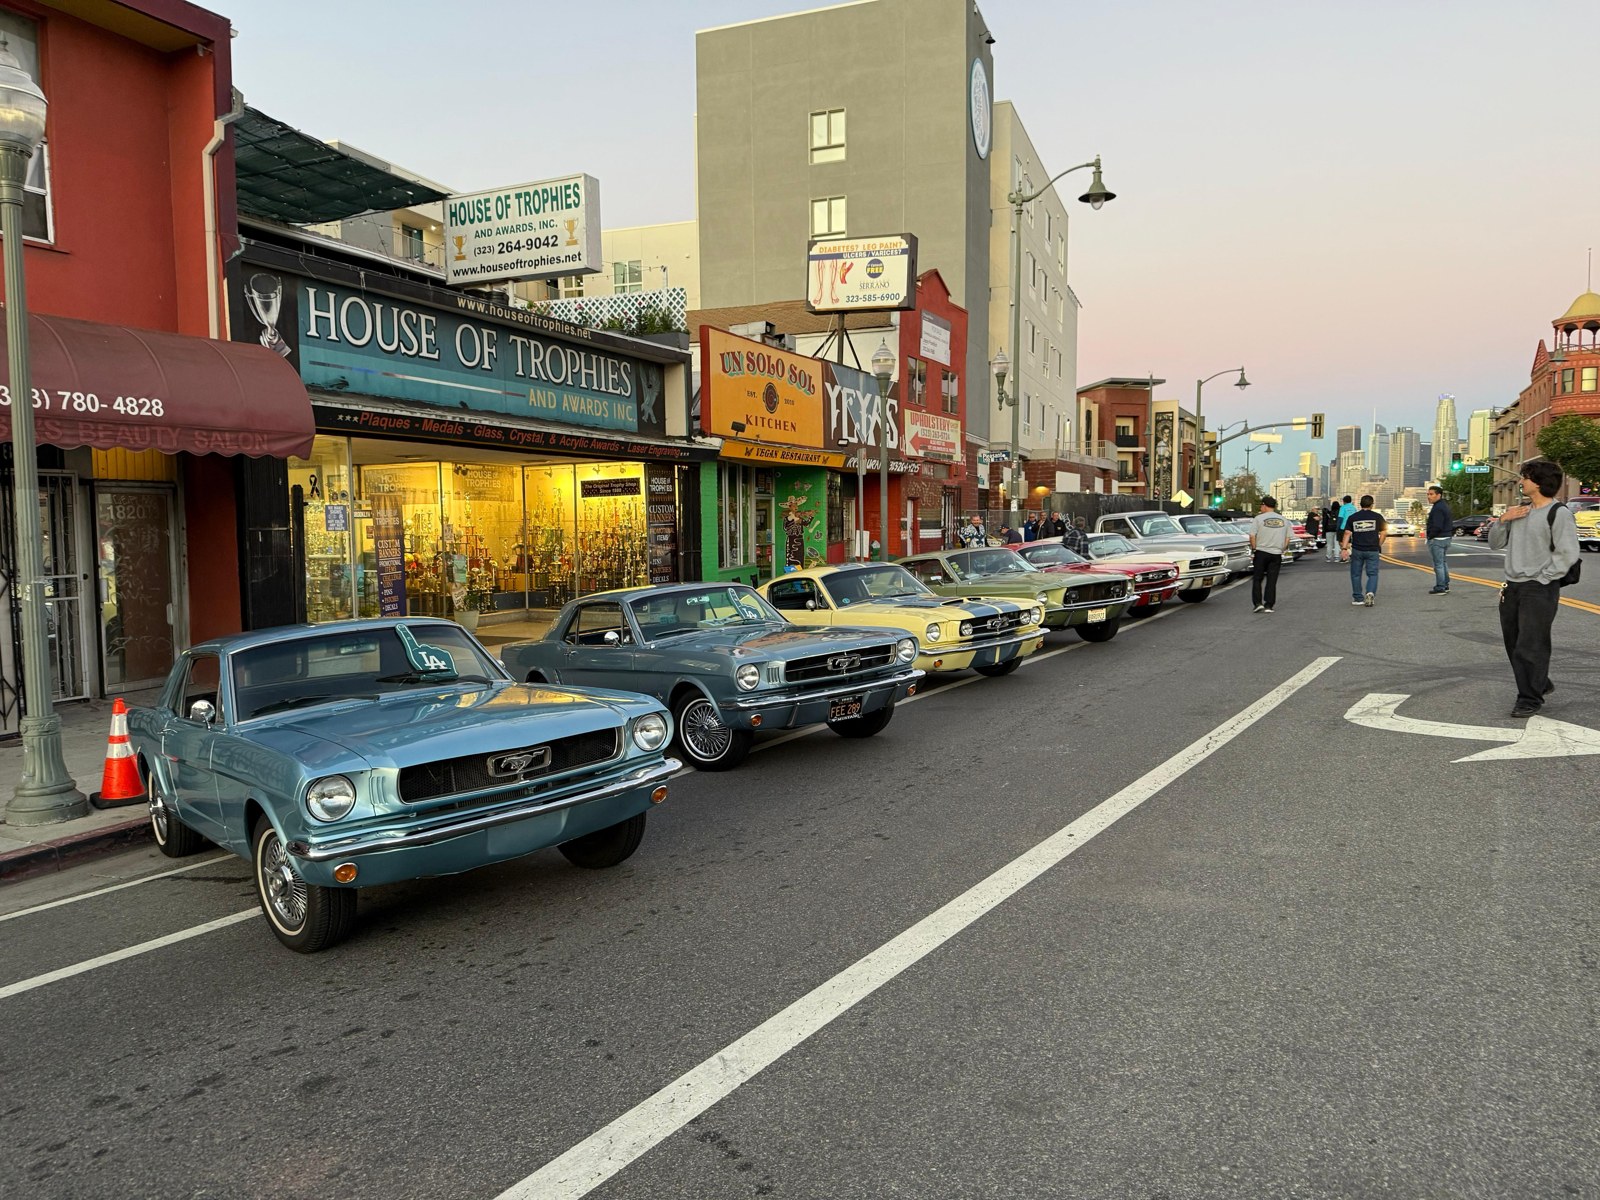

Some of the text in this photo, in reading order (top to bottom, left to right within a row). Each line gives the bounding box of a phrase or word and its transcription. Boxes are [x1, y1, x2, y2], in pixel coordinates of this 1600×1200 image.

[449, 183, 581, 227] HOUSE OF TROPHIES
[474, 219, 558, 239] AND AWARDS, INC.
[473, 234, 559, 258] (323) 264-9042
[819, 241, 902, 254] DIABETES? LEG PAIN?
[843, 251, 866, 259] ULCERS
[452, 251, 582, 278] www.houseoftrophies.net
[866, 266, 884, 274] FREE
[860, 281, 890, 290] SERRANO
[846, 292, 900, 303] 323-585-6900
[457, 297, 592, 340] www.houseoftrophies.net
[305, 287, 632, 398] HOUSE OF TROPHIES
[720, 350, 816, 396] UN SOLO SOL
[0, 386, 50, 410] 33)
[746, 390, 757, 398] EST.
[529, 388, 636, 422] AND AWARDS INC.
[745, 414, 797, 433] KITCHEN
[910, 411, 951, 432] UPHOLSTERY
[79, 421, 181, 448] BEAUTY
[194, 430, 268, 450] SALON
[359, 412, 411, 430] Plaques
[421, 419, 464, 436] Medals
[473, 425, 506, 442] Glass,
[509, 429, 545, 445] Crystal,
[549, 436, 557, 445] &
[559, 435, 590, 452] Acrylic
[591, 439, 620, 451] Awards
[627, 445, 647, 454] Laser
[649, 445, 681, 459] Engraving
[756, 447, 822, 464] VEGAN RESTAURANT
[468, 470, 492, 479] HOUSE
[106, 504, 145, 520] 1820
[649, 504, 675, 514] CUSTOM
[650, 513, 675, 522] BANNERS
[377, 539, 401, 549] CUSTOM
[378, 548, 402, 559] BANNERS
[652, 576, 670, 584] DECALS
[742, 607, 758, 618] LA
[418, 651, 448, 669] LA
[830, 702, 861, 719] FEE 289
